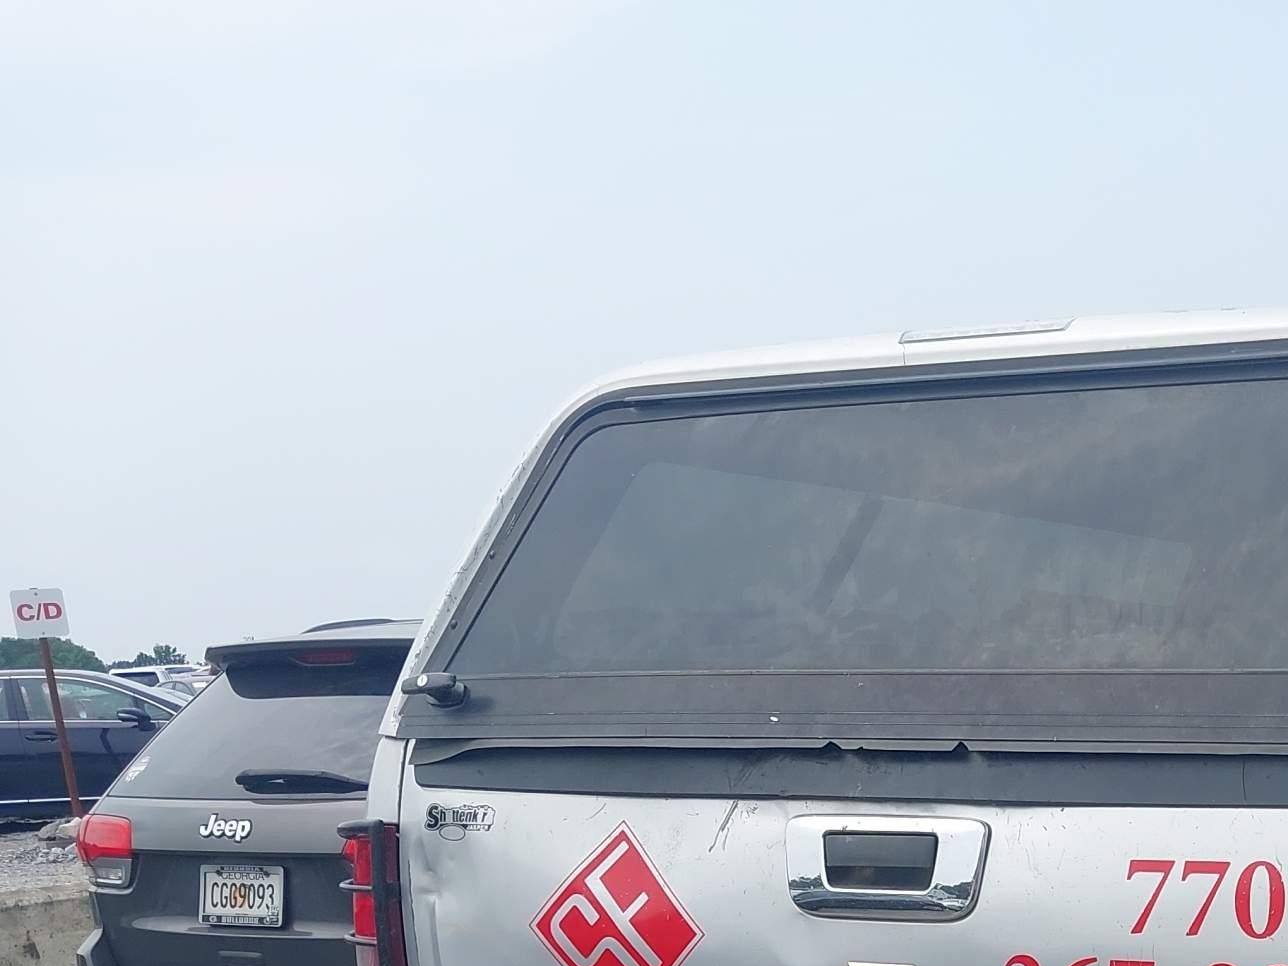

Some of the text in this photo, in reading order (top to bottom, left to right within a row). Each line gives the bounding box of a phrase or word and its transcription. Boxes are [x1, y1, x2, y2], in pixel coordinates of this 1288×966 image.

[16, 602, 63, 622] C/D
[199, 811, 252, 842] Jeep
[1126, 858, 1286, 940] 770
